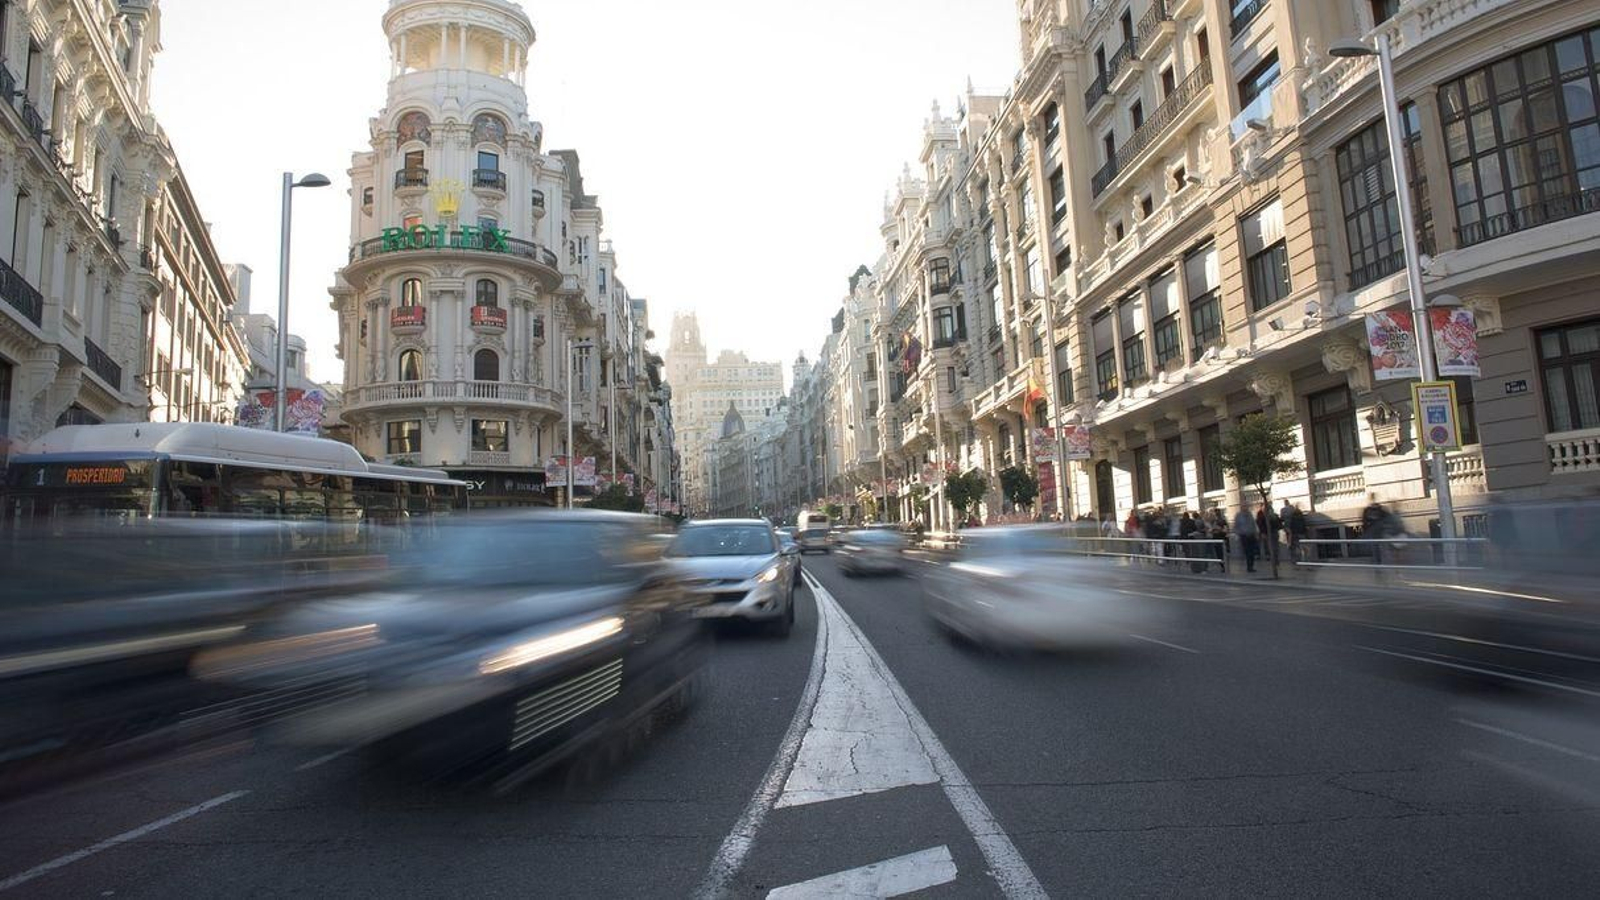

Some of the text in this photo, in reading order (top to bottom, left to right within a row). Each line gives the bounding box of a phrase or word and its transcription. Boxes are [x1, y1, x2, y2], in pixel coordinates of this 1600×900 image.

[381, 224, 511, 253] ROLEX
[1386, 341, 1405, 350] 2017
[36, 467, 125, 486] 1 PROSPERIDAD
